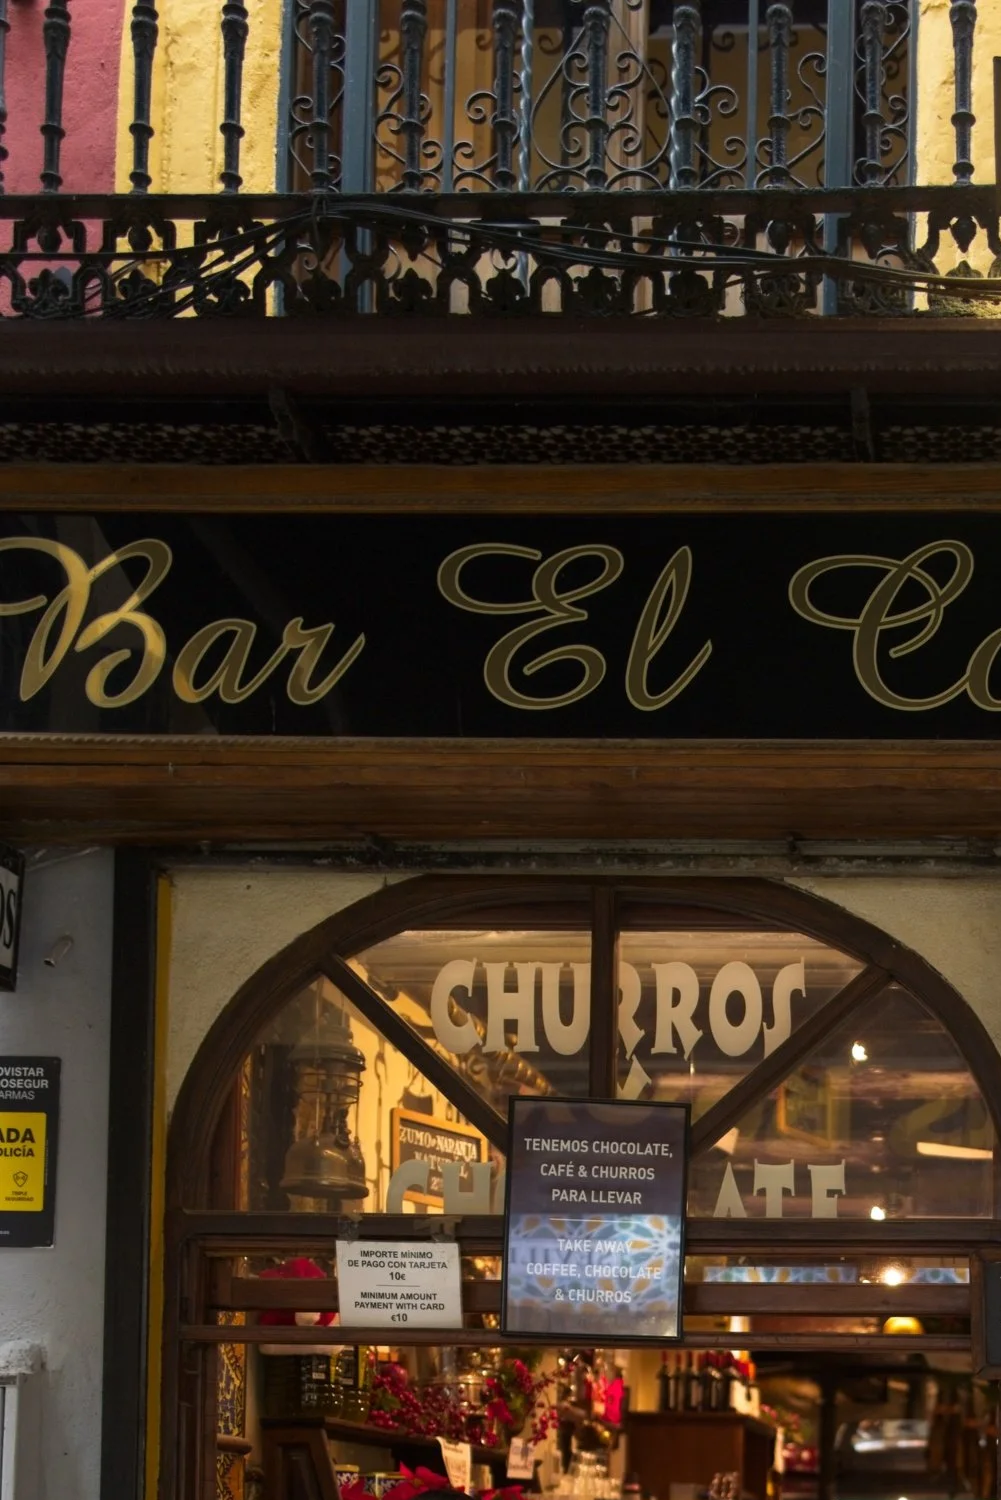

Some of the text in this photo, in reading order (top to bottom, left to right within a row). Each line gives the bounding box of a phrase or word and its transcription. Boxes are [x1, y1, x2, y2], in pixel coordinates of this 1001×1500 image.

[0, 537, 365, 708] Bar
[437, 543, 712, 711] El
[524, 1138, 673, 1158] TENEMOS CHOCOLATE,
[540, 1161, 655, 1181] CAFÉ & CHURROS
[551, 1188, 642, 1205] PARA LLEVAR
[557, 1238, 633, 1254] TAKE AWAY
[360, 1250, 399, 1259] IMPORTE
[347, 1260, 448, 1270] DE PAGO CON TARJETA
[526, 1262, 662, 1280] COFFEE, CHOCOLATE
[389, 1272, 406, 1281] 10€
[360, 1291, 438, 1301] MINIMUM AMOUNT
[555, 1288, 632, 1304] & CHURROS
[354, 1301, 445, 1311] PAYMENT WITH CARD
[391, 1313, 408, 1322] €10
